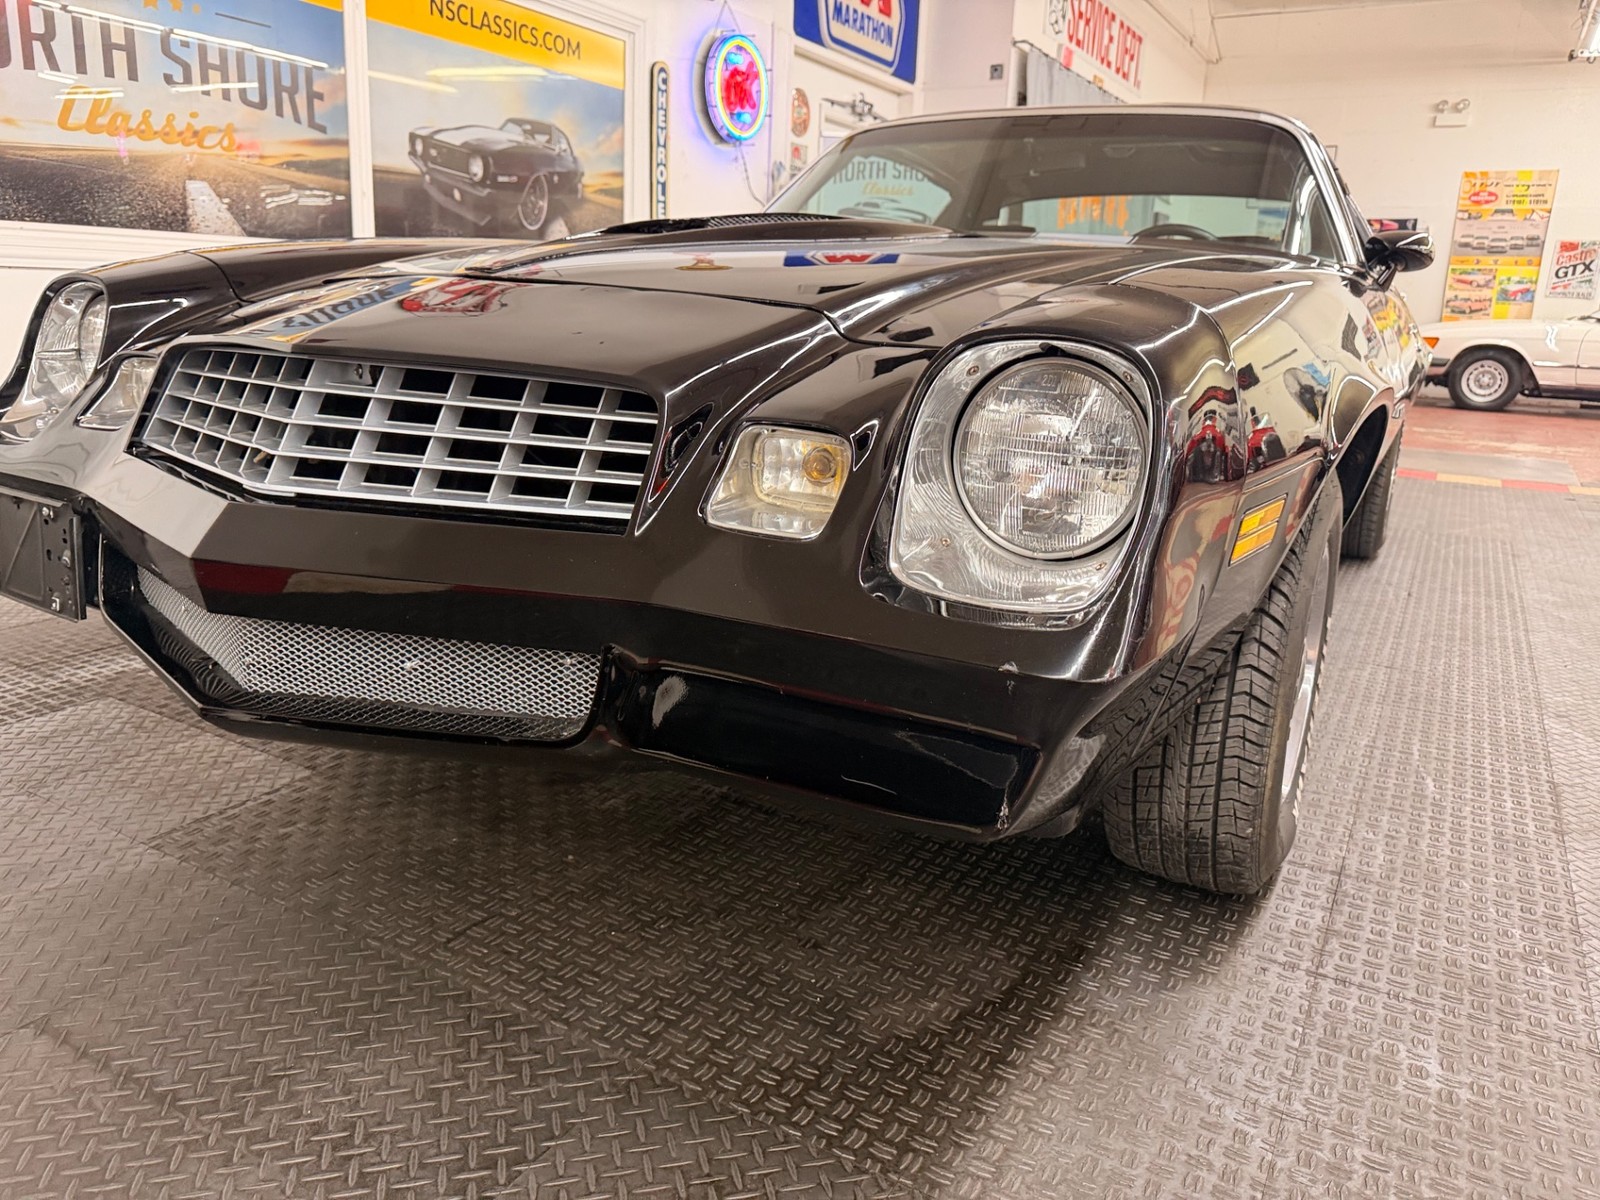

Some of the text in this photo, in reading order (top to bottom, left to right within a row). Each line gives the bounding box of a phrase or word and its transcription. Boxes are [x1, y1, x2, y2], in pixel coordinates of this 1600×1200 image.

[430, 0, 582, 60] NSCLASSICS.COM
[833, 0, 894, 48] MARATHON
[1067, 0, 1143, 90] SERVICE DEPT.
[160, 29, 328, 135] SHORE
[57, 85, 238, 152] Classics
[1554, 259, 1595, 280] GTX
